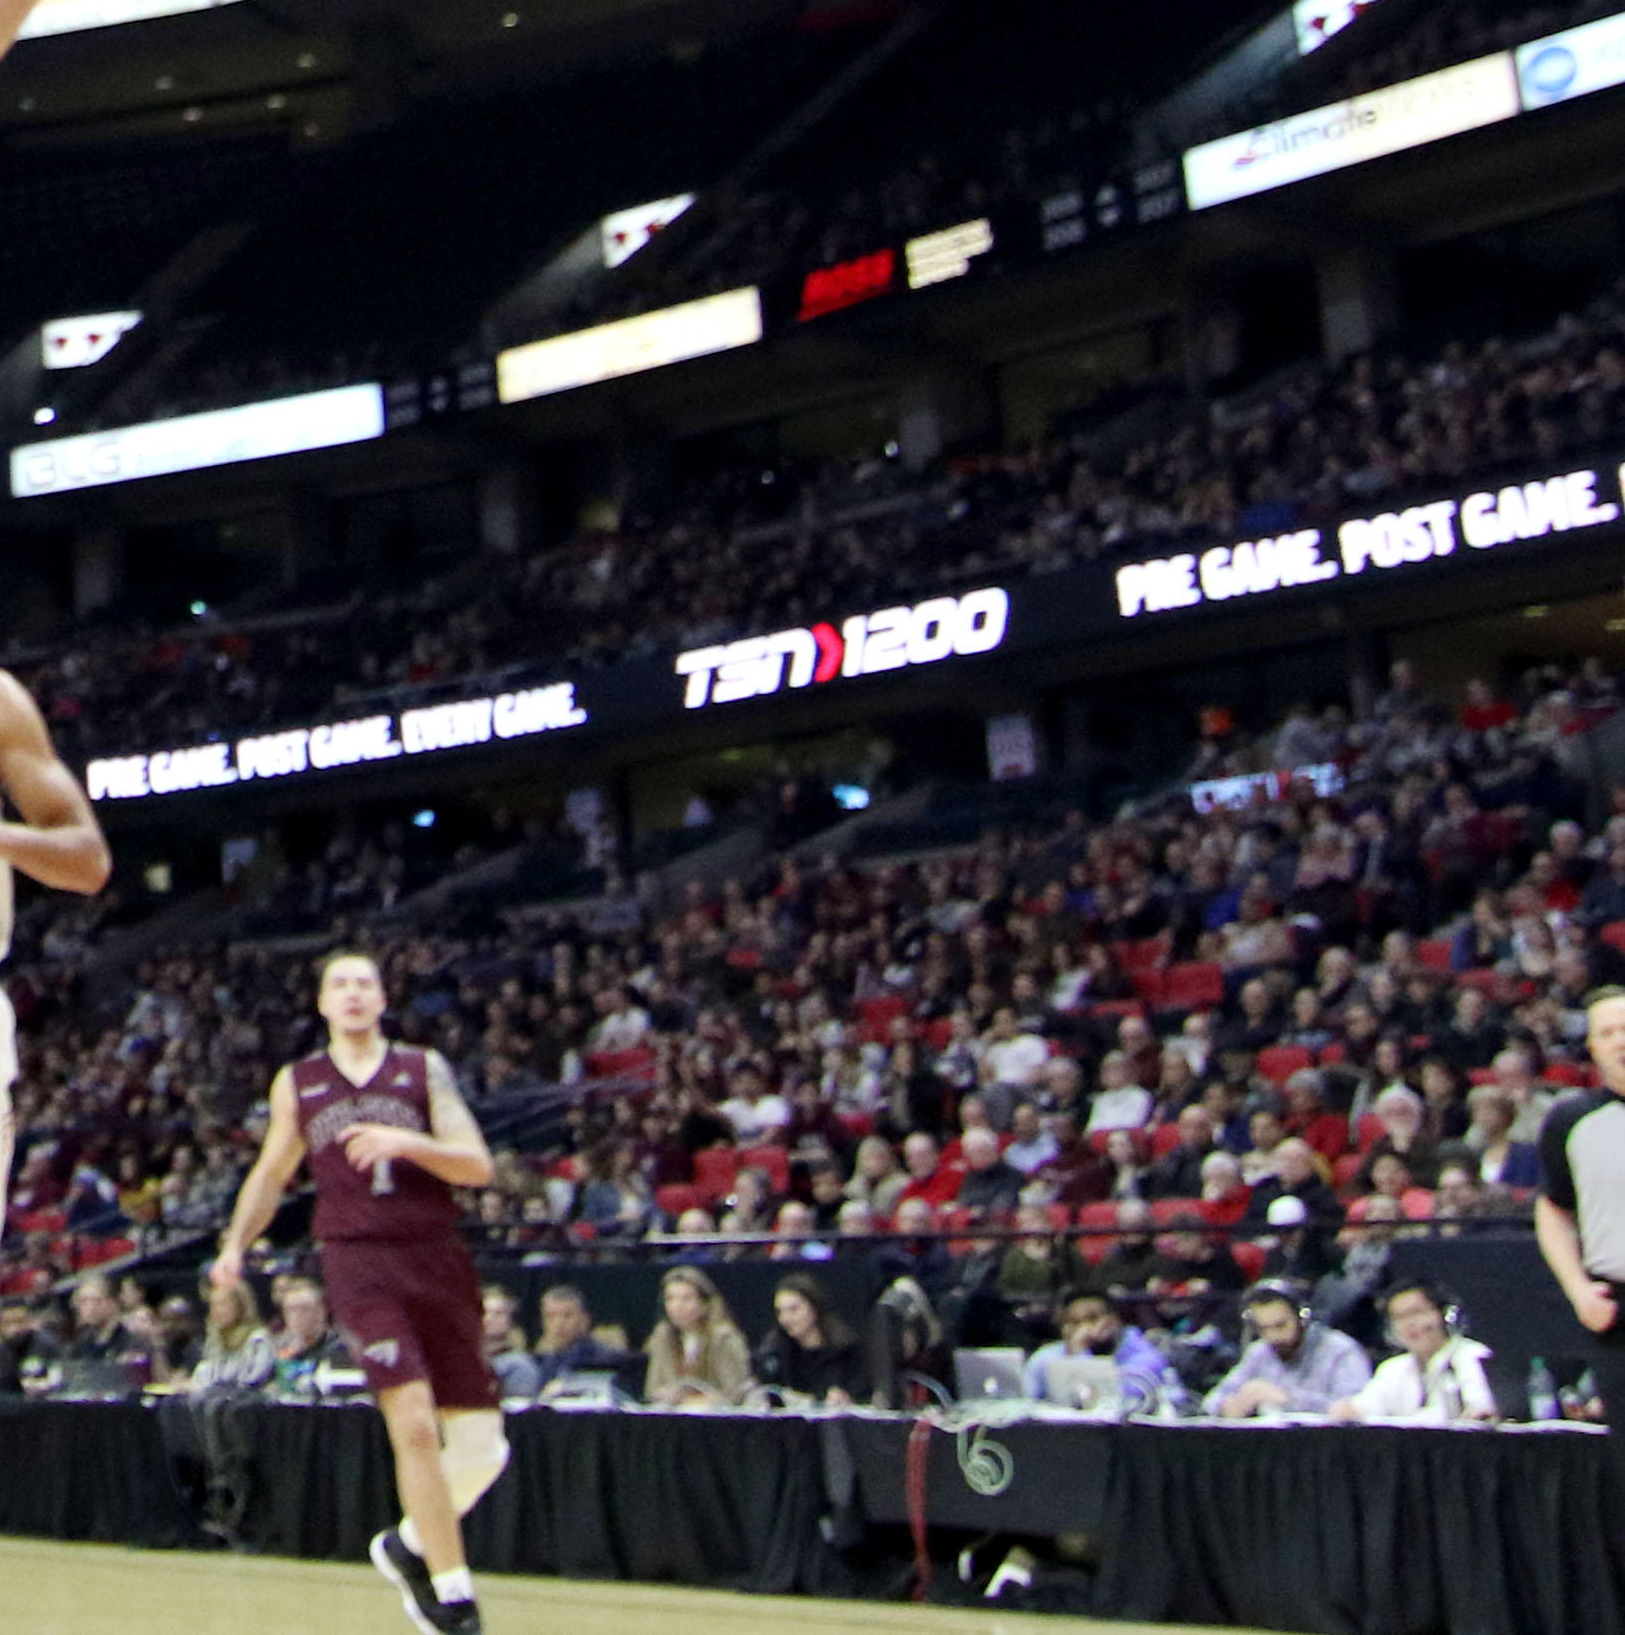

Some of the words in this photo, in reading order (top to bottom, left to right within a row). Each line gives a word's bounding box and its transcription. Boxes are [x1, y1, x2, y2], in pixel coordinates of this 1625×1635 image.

[1116, 554, 1202, 617] PRE
[1201, 528, 1340, 601] GAME.
[1338, 499, 1458, 574] POST
[1459, 469, 1620, 550] GAME.
[676, 628, 817, 709] TSN
[842, 587, 1010, 678] 1200
[86, 755, 150, 800] PRE
[149, 743, 238, 795] GAME.
[237, 729, 309, 781] POST
[308, 715, 403, 769] GAME.
[493, 681, 588, 739] GAME.
